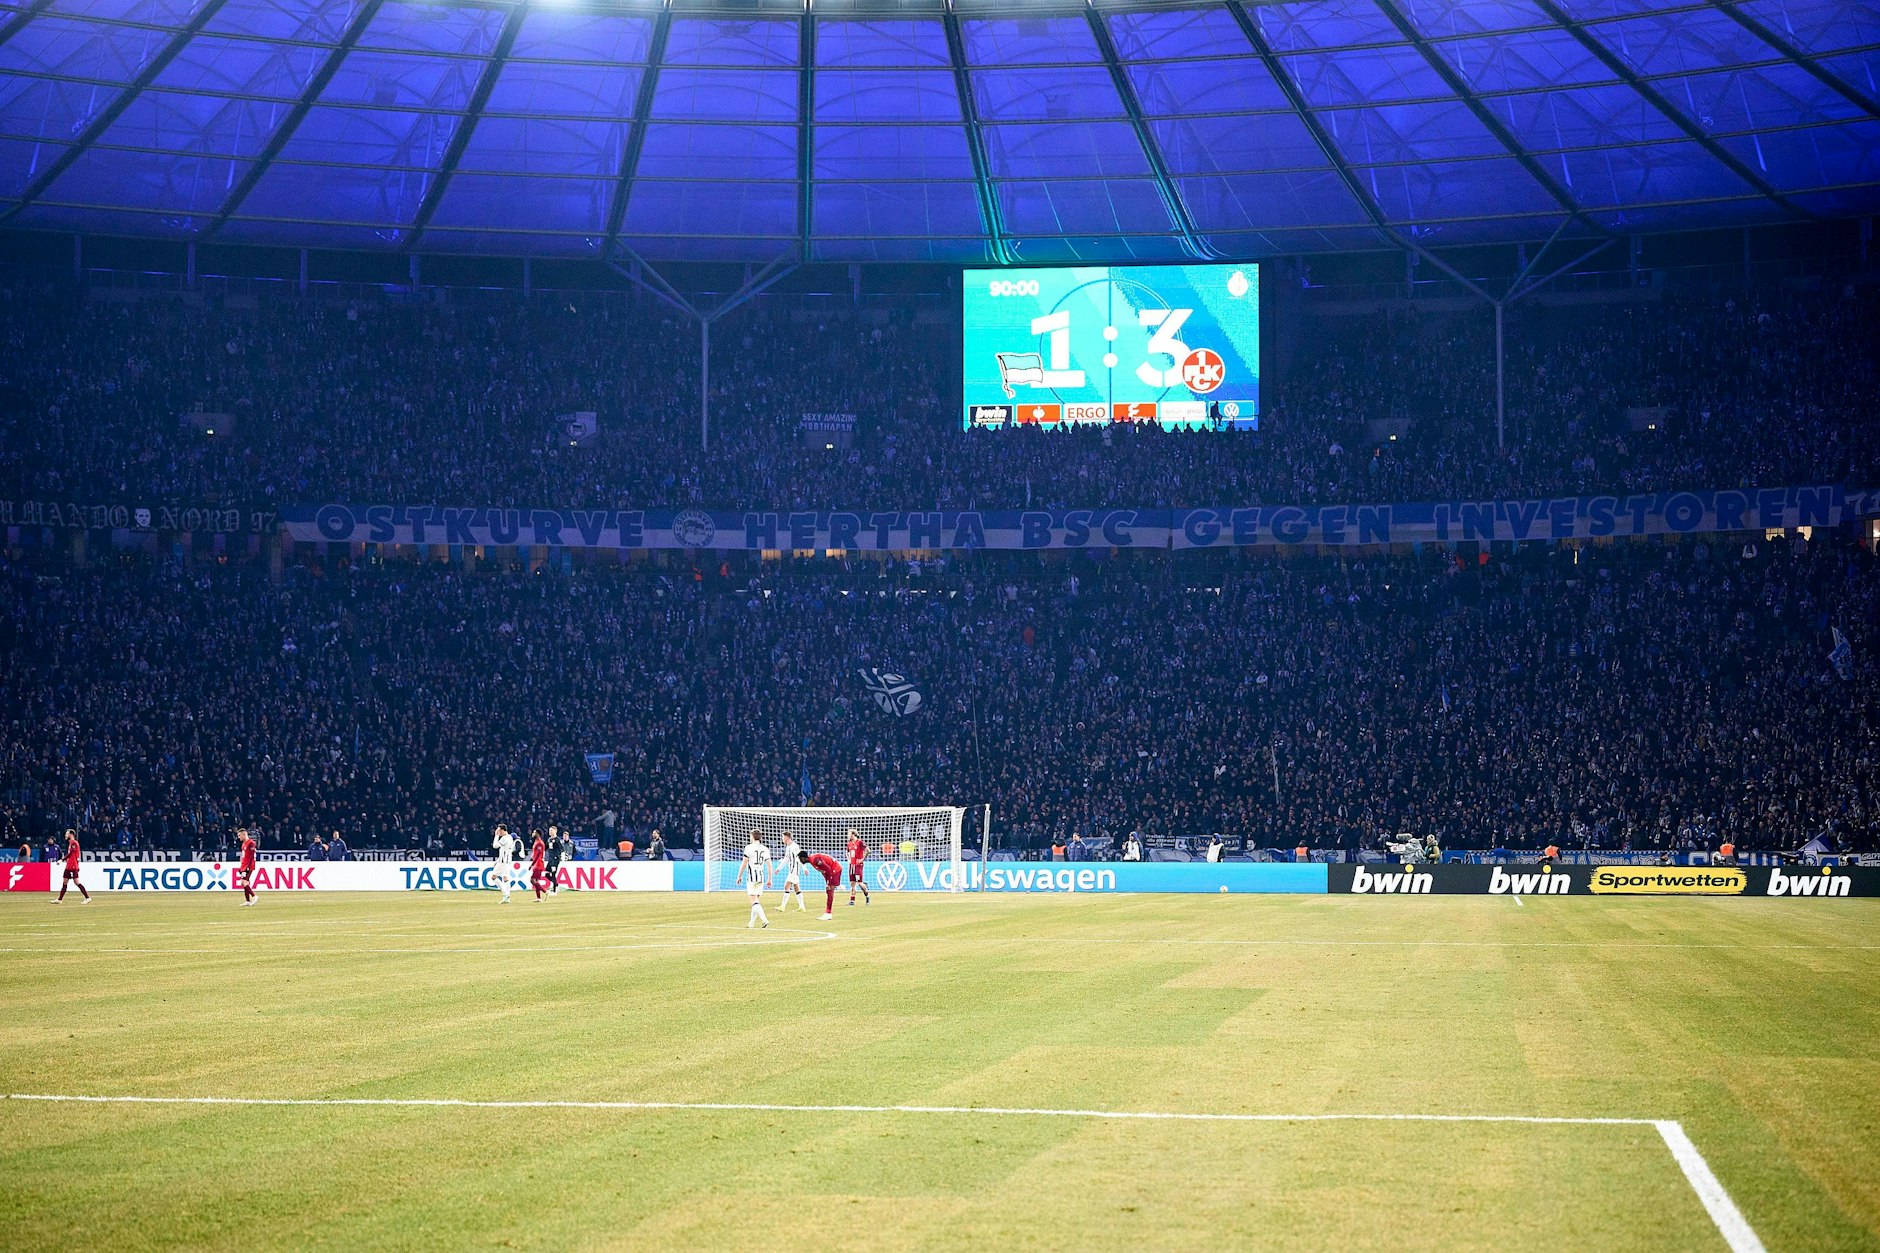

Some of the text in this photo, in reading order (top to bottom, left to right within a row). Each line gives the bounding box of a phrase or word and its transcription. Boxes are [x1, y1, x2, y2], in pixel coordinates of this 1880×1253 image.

[989, 280, 1040, 297] 90:00
[1136, 308, 1193, 388] 3
[1067, 407, 1106, 419] ERGO
[160, 504, 240, 533] NORD
[315, 486, 1835, 549] OSTKURVE HERTHA BSC GEGEN INVESTOREN
[754, 850, 764, 865] 16
[917, 861, 1116, 892] Volkswagen
[1350, 864, 1433, 894] bwin
[1488, 864, 1571, 895] bwin
[1598, 873, 1739, 889] Sportwetten
[1767, 866, 1852, 897] bwin
